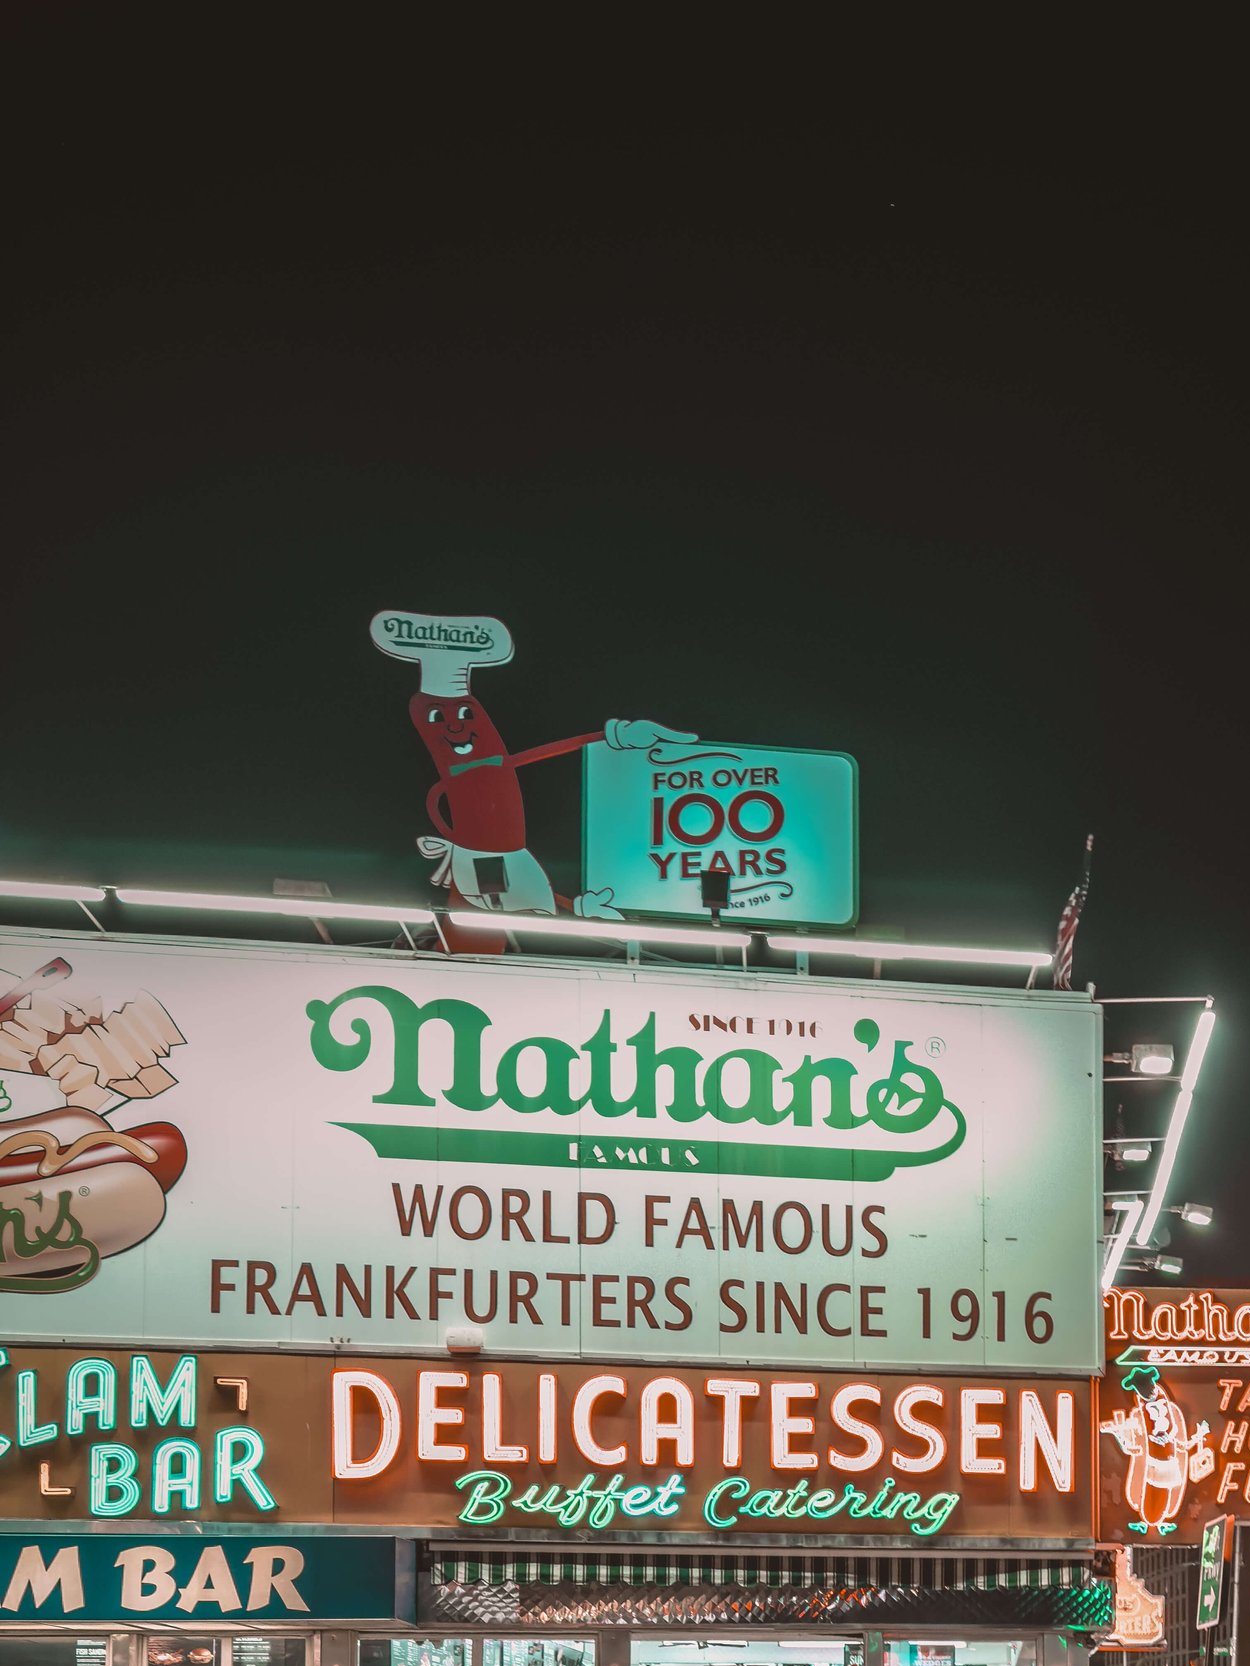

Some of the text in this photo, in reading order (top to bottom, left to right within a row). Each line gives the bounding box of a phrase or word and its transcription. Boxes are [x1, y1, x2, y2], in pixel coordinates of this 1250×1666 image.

[383, 617, 494, 645] Nathan's
[652, 767, 780, 791] FOR OVER
[651, 790, 785, 847] 100
[648, 848, 787, 881] YEARS
[748, 893, 771, 906] 1916
[688, 1013, 824, 1038] SINCE 1916
[306, 985, 966, 1134] Nathan's
[568, 1142, 700, 1166] FAMOUS
[391, 1182, 889, 1259] WORLD FAMOUS
[210, 1259, 1054, 1344] FRANKFURTERS SINCE 1916
[0, 1347, 197, 1458] LAM
[331, 1368, 1075, 1493] DELICATESSEN
[90, 1425, 280, 1516] BAR
[455, 1470, 961, 1537] Buffet Catering
[0, 1545, 310, 1614] M BAR
